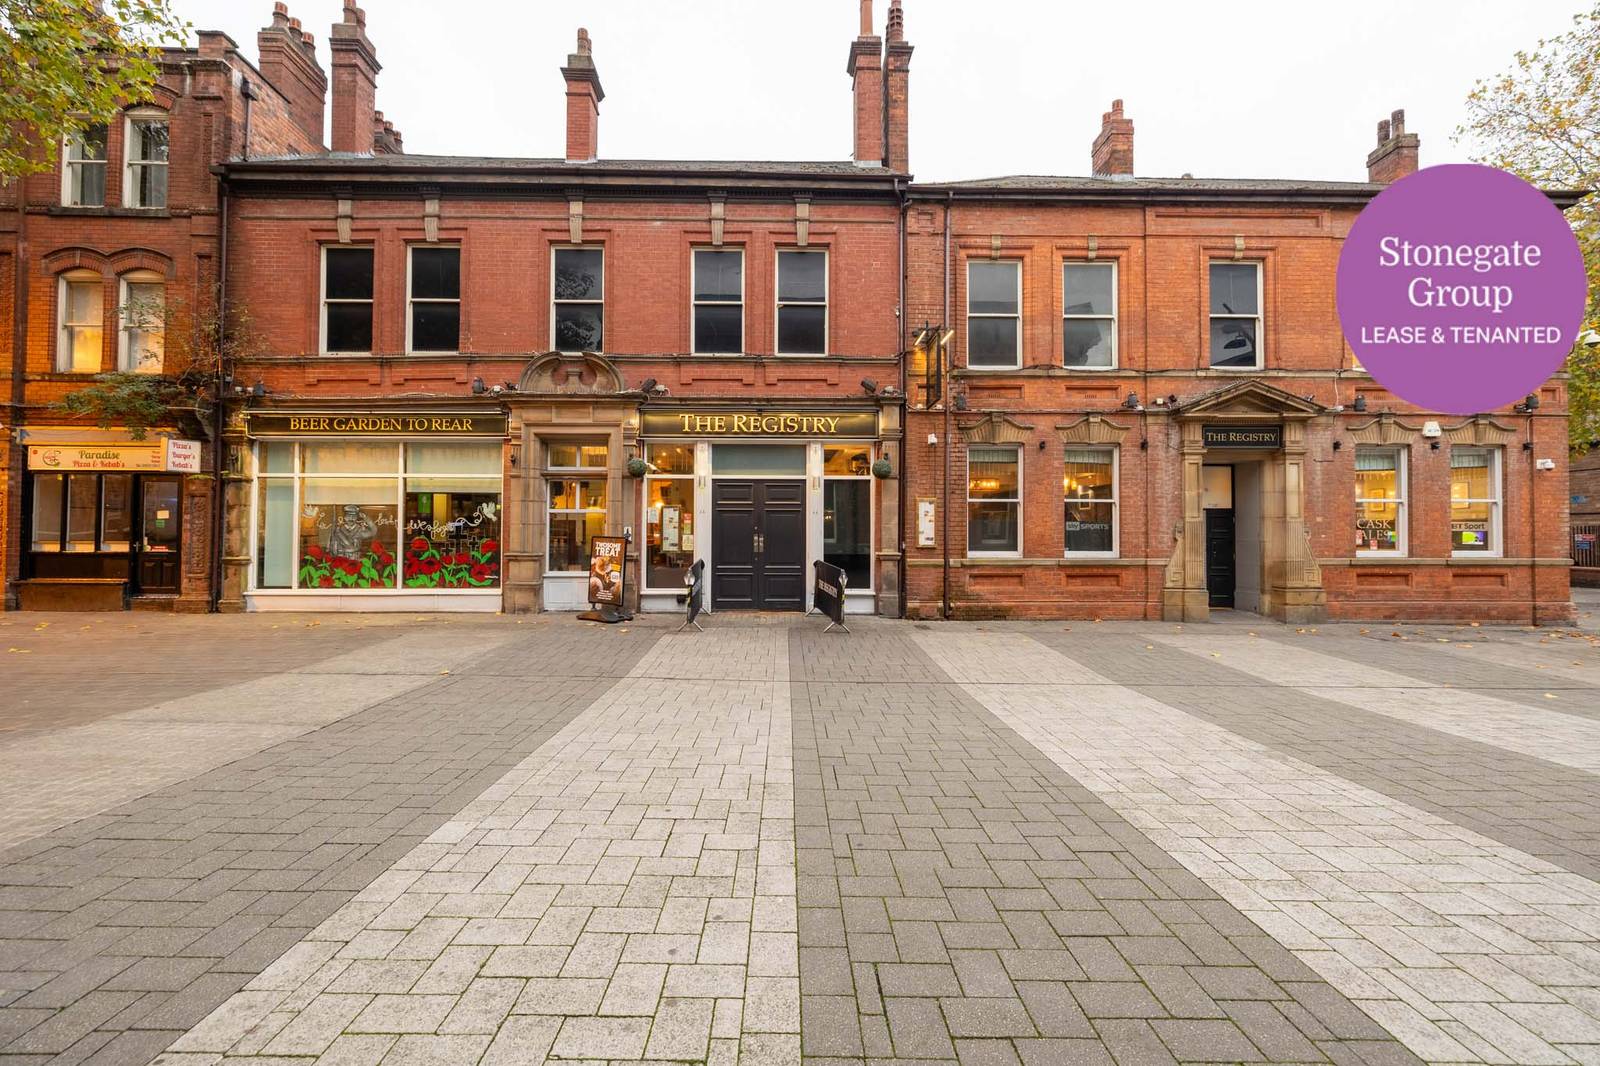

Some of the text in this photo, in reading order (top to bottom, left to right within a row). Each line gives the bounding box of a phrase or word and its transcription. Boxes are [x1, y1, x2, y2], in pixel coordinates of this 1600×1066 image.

[289, 418, 472, 431] BEER GARDEN TO REAR
[679, 413, 840, 433] THE REGISTRY
[1206, 432, 1277, 442] THE REGISTRY
[78, 449, 121, 460] Paradise
[1356, 518, 1392, 529] CASK
[1451, 522, 1485, 531] BT Sport
[595, 548, 620, 557] TREAT
